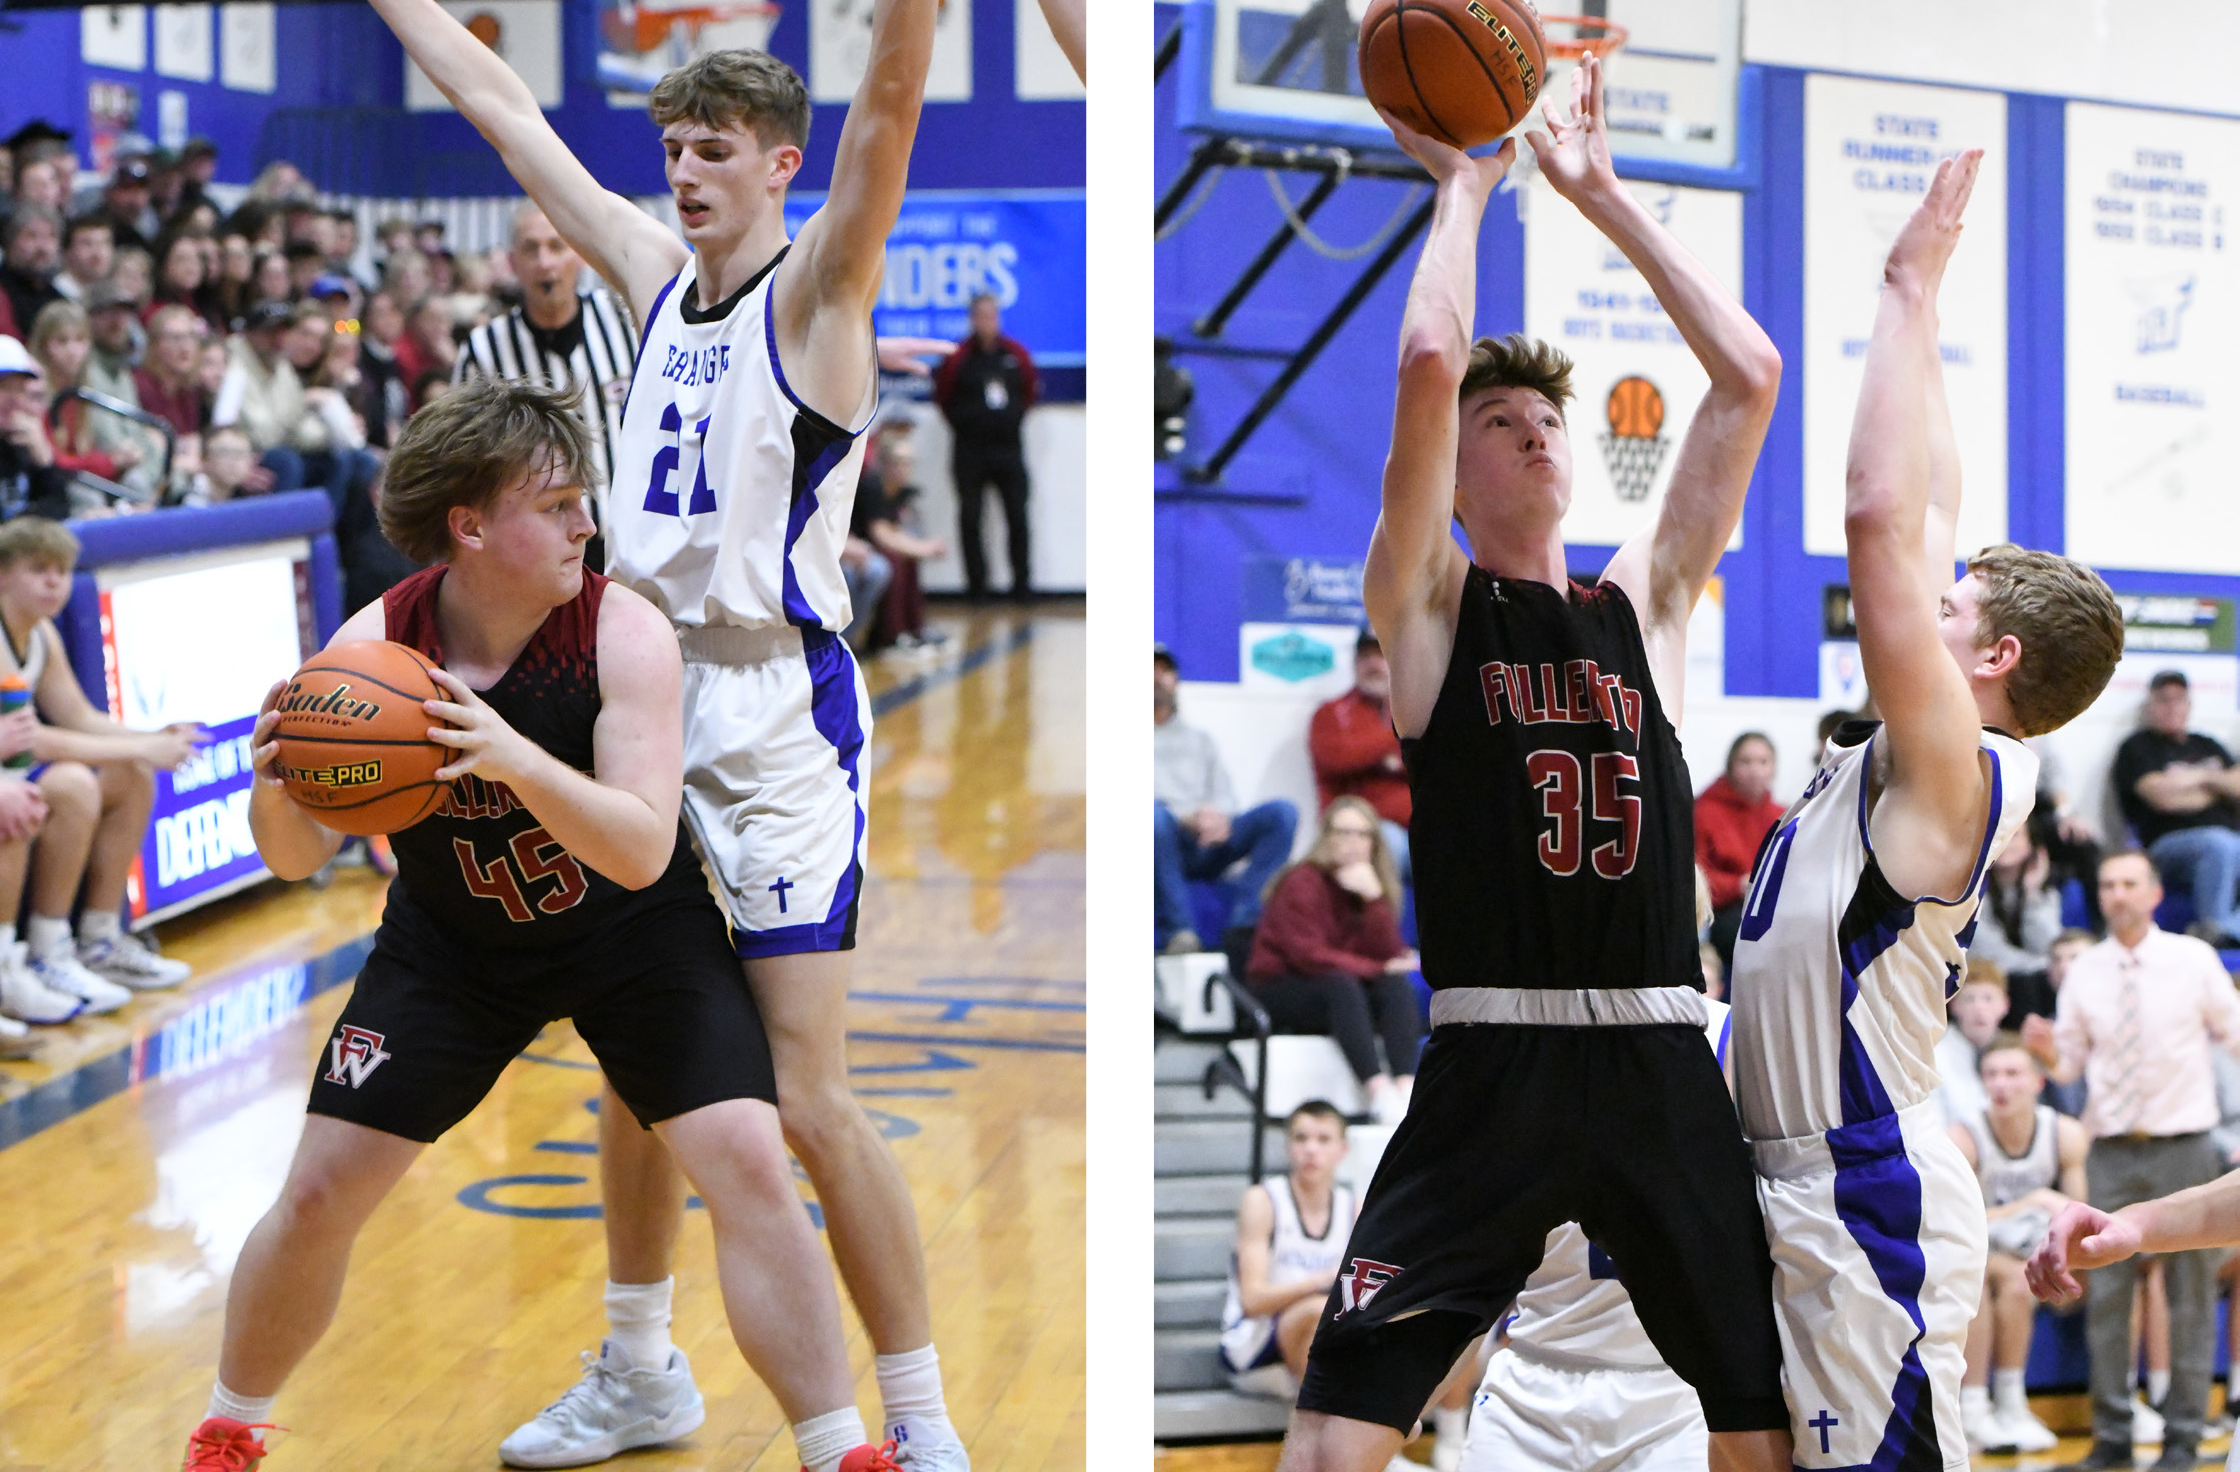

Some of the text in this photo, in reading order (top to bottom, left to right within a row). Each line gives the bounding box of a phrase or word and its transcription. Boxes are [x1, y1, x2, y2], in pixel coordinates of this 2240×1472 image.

[1466, 0, 1532, 77] ELITE
[1873, 113, 1938, 139] STATE
[643, 401, 717, 517] 21
[277, 682, 382, 722] Baden
[1525, 749, 1642, 881] 35
[452, 825, 589, 923] 45
